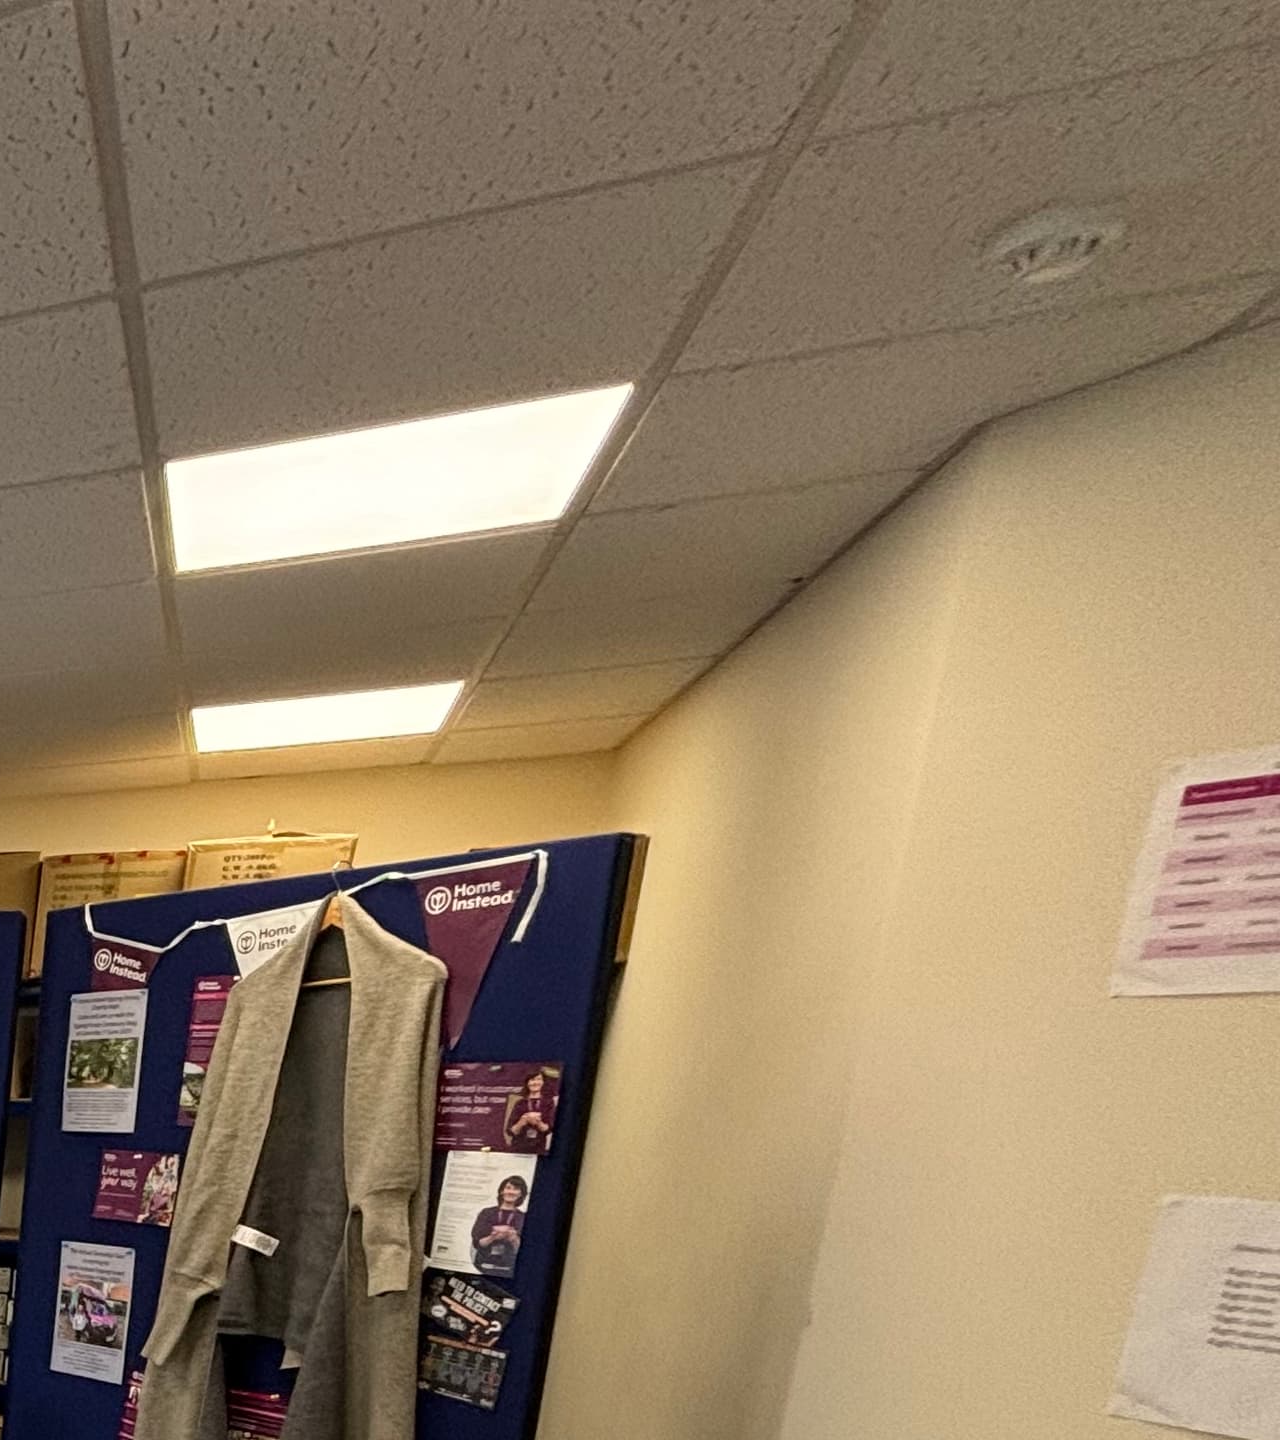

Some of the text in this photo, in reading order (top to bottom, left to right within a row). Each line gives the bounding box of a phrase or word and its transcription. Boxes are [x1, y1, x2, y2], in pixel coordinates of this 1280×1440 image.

[454, 880, 502, 897] Home
[451, 889, 514, 912] Instead
[258, 922, 297, 939] Home
[258, 937, 289, 951] Inste
[113, 952, 142, 970] Home
[109, 963, 147, 983] Instead
[102, 1165, 119, 1176] Live
